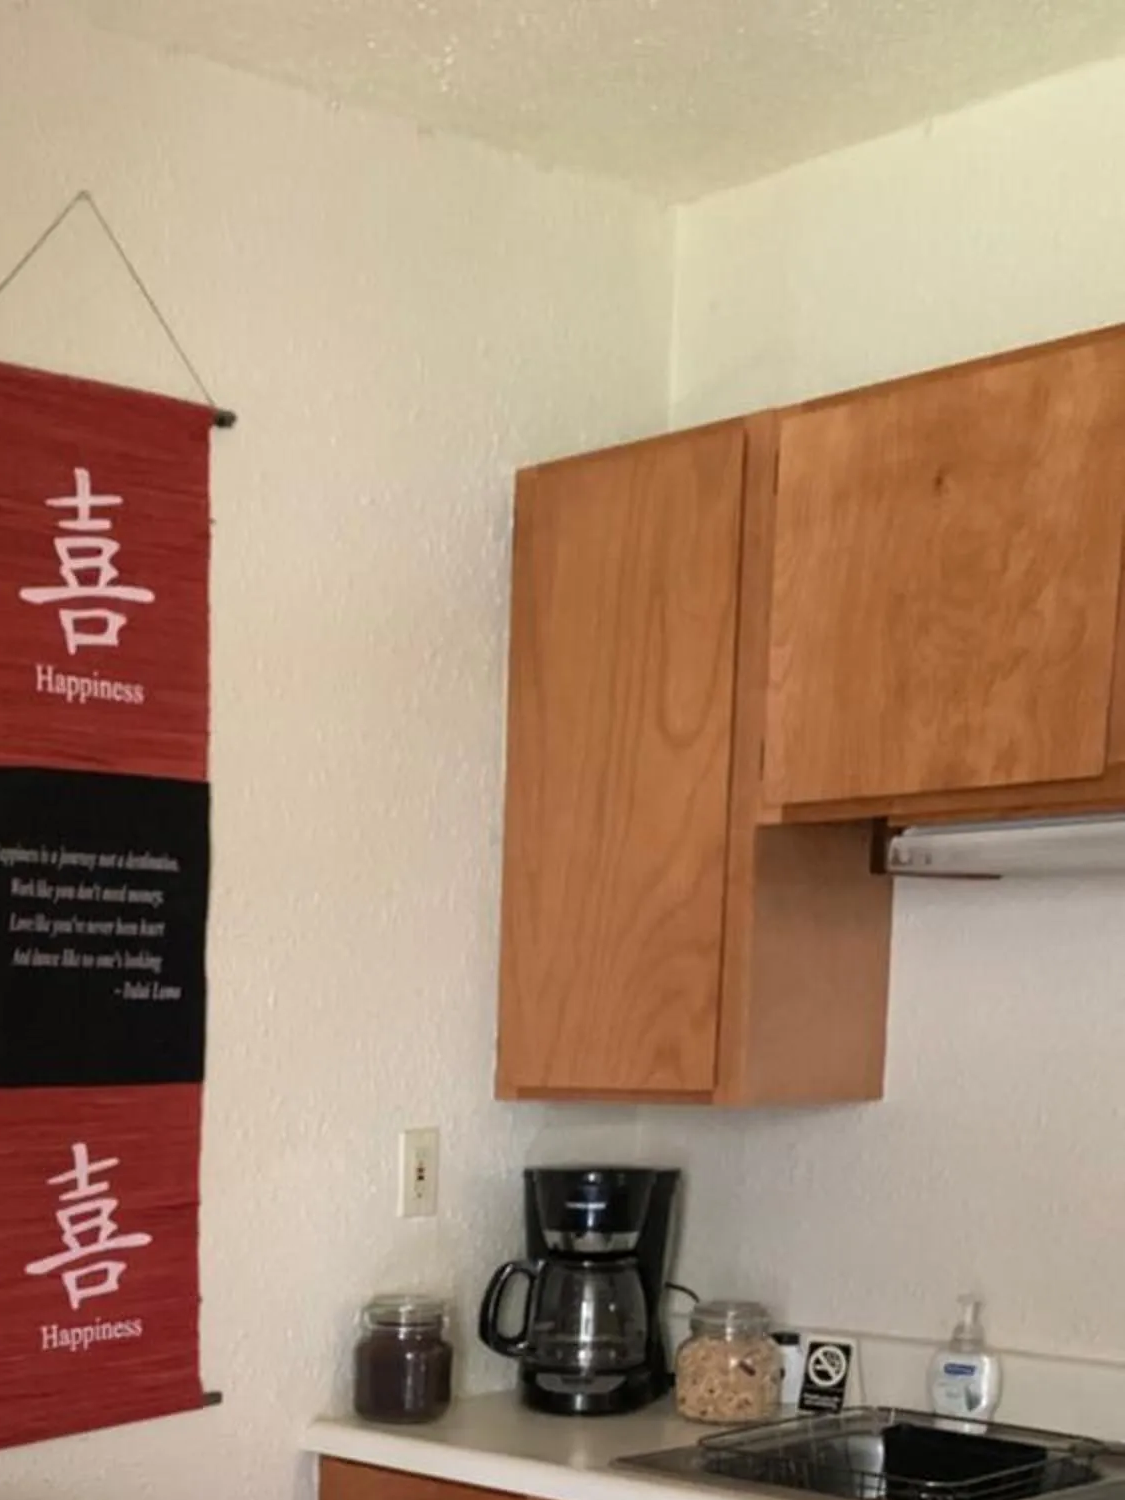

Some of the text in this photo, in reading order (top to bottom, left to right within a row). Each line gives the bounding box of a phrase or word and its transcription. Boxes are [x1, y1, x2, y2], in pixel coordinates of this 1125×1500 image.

[18, 467, 155, 656] 喜
[35, 664, 144, 704] Happiness
[24, 1142, 153, 1310] 喜
[41, 1318, 143, 1351] Happiness
